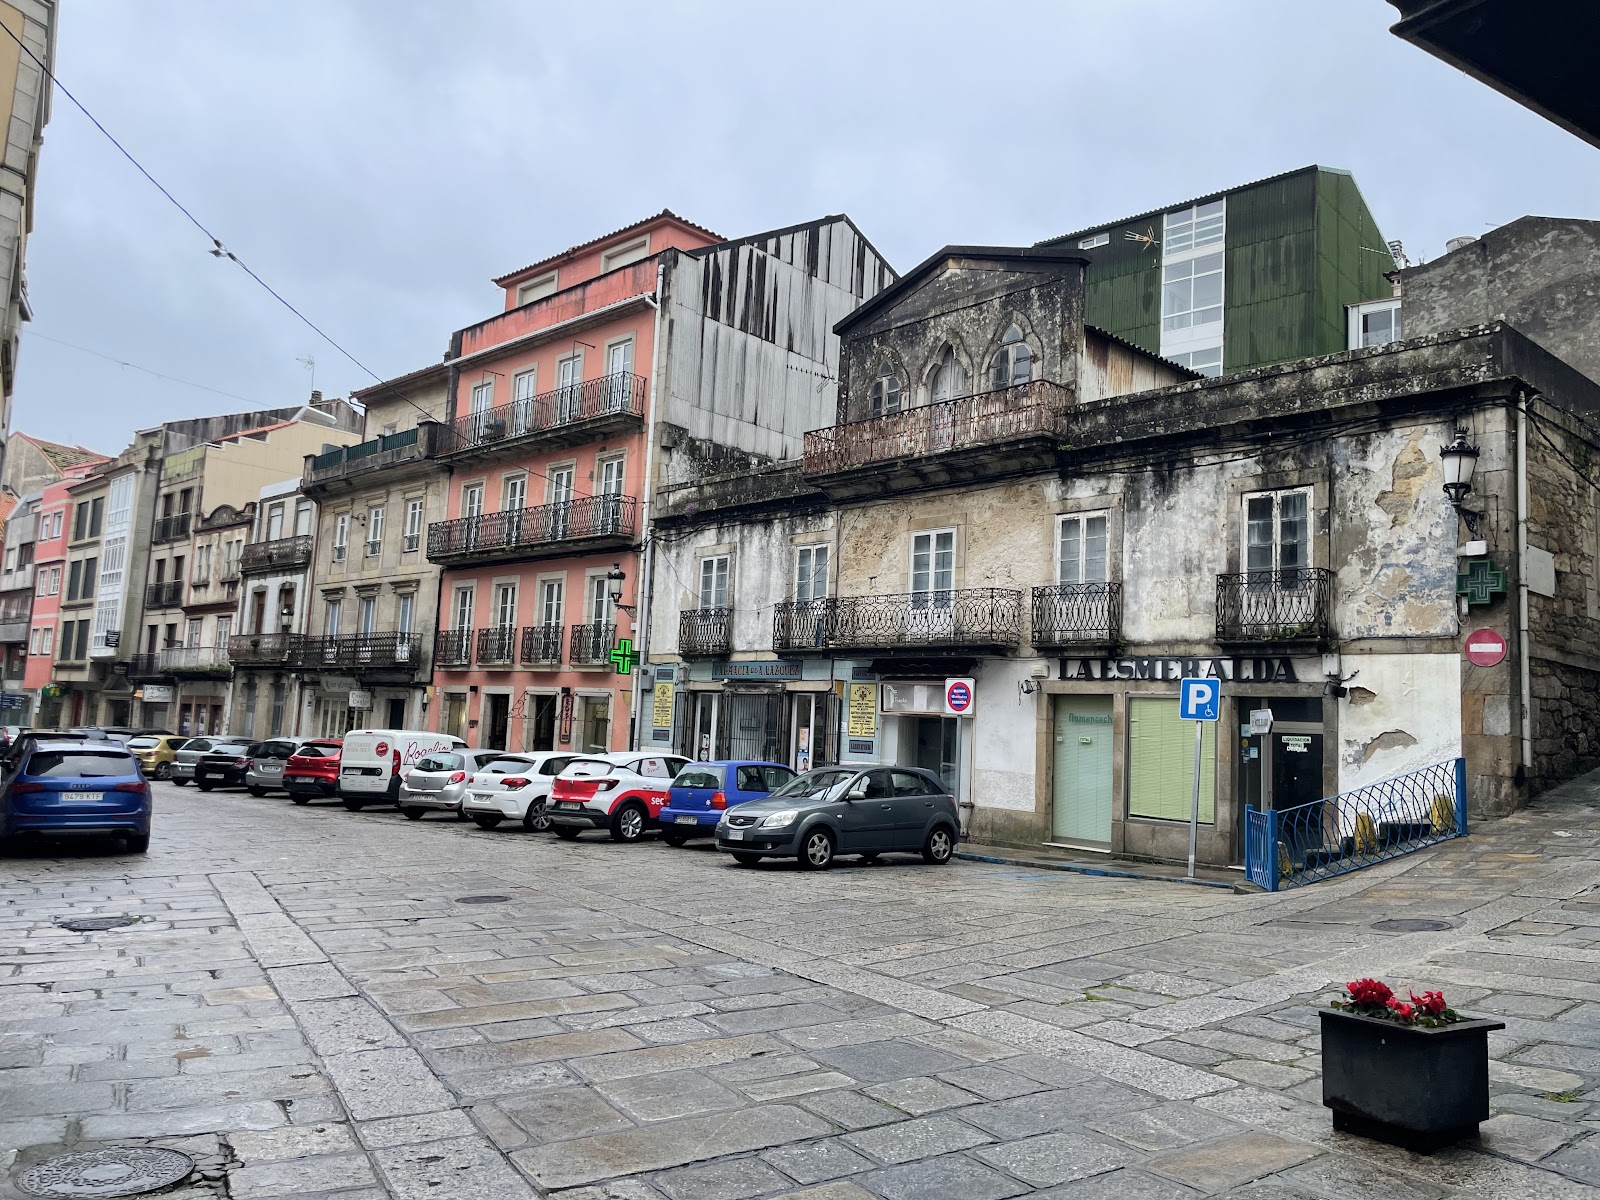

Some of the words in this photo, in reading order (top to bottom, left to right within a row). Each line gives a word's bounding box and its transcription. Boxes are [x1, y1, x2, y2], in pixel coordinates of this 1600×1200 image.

[714, 665, 749, 676] FARMACIA
[1058, 657, 1099, 681] LA
[1100, 656, 1299, 683] ESMERALDA
[1188, 683, 1212, 715] P
